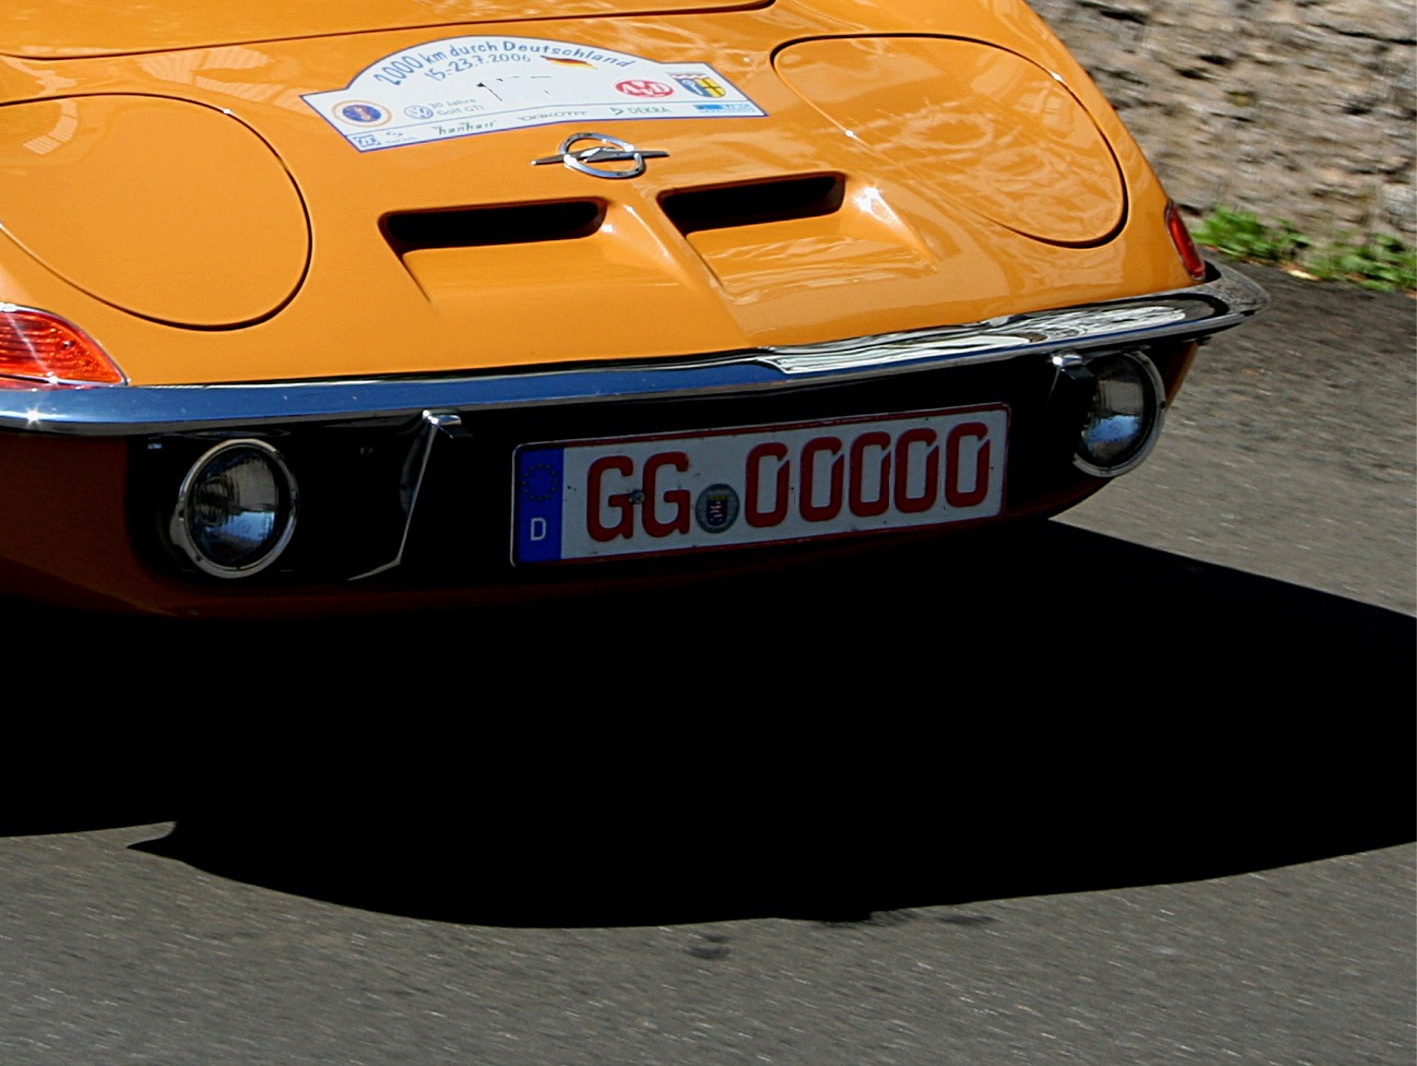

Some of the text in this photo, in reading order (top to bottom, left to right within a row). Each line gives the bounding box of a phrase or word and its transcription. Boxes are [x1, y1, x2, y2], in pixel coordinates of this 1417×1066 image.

[373, 40, 637, 85] 2000 km durch Deutschland
[627, 106, 672, 115] DEKRA
[586, 421, 991, 543] GG 00000
[529, 517, 548, 542] D
